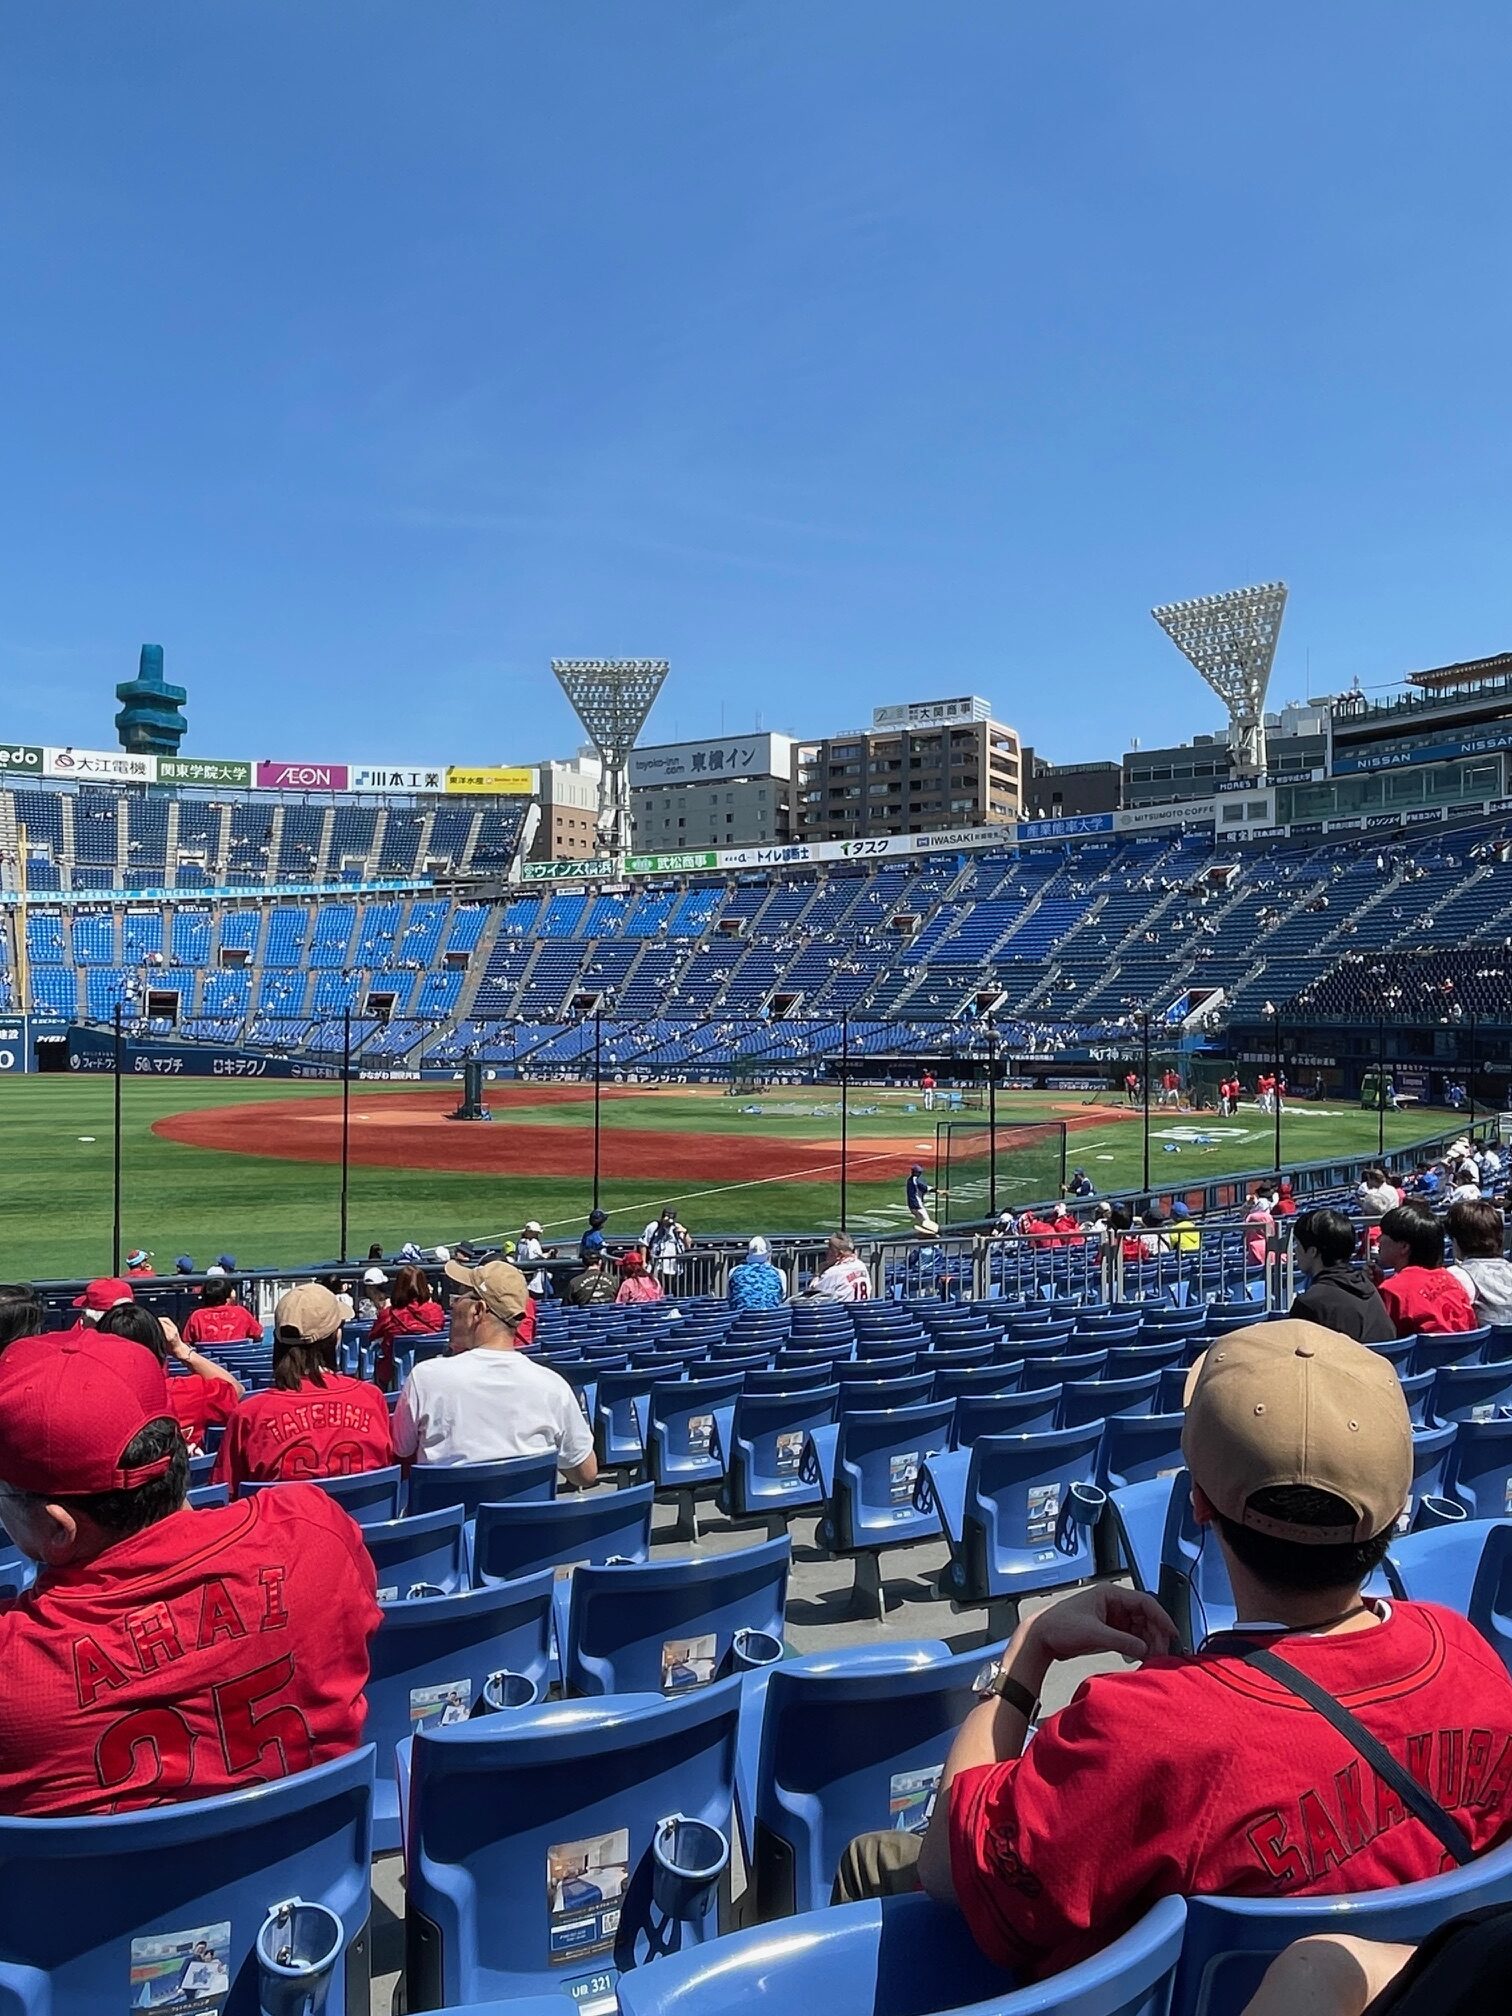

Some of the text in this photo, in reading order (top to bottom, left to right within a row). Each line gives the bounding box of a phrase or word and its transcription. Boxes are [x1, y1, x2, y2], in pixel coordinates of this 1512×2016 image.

[77, 757, 147, 776] 大江電機
[691, 748, 756, 773] 東横イン
[1357, 752, 1411, 769] NISSAN
[160, 763, 247, 781] 関東学院大学
[371, 771, 440, 788] 川本工業
[1134, 809, 1183, 822] MITSUMOTO
[852, 839, 889, 855] タスク
[930, 833, 974, 846] IWASAKI
[535, 858, 612, 876] ウインズ横浜
[656, 854, 708, 870] 武松商事
[153, 1057, 183, 1073] マブチ
[852, 1281, 869, 1301] 18
[266, 1401, 371, 1445] TATSUMI
[72, 1565, 289, 1709] ARAI
[94, 1650, 316, 1815] 25
[590, 1974, 611, 1994] 321
